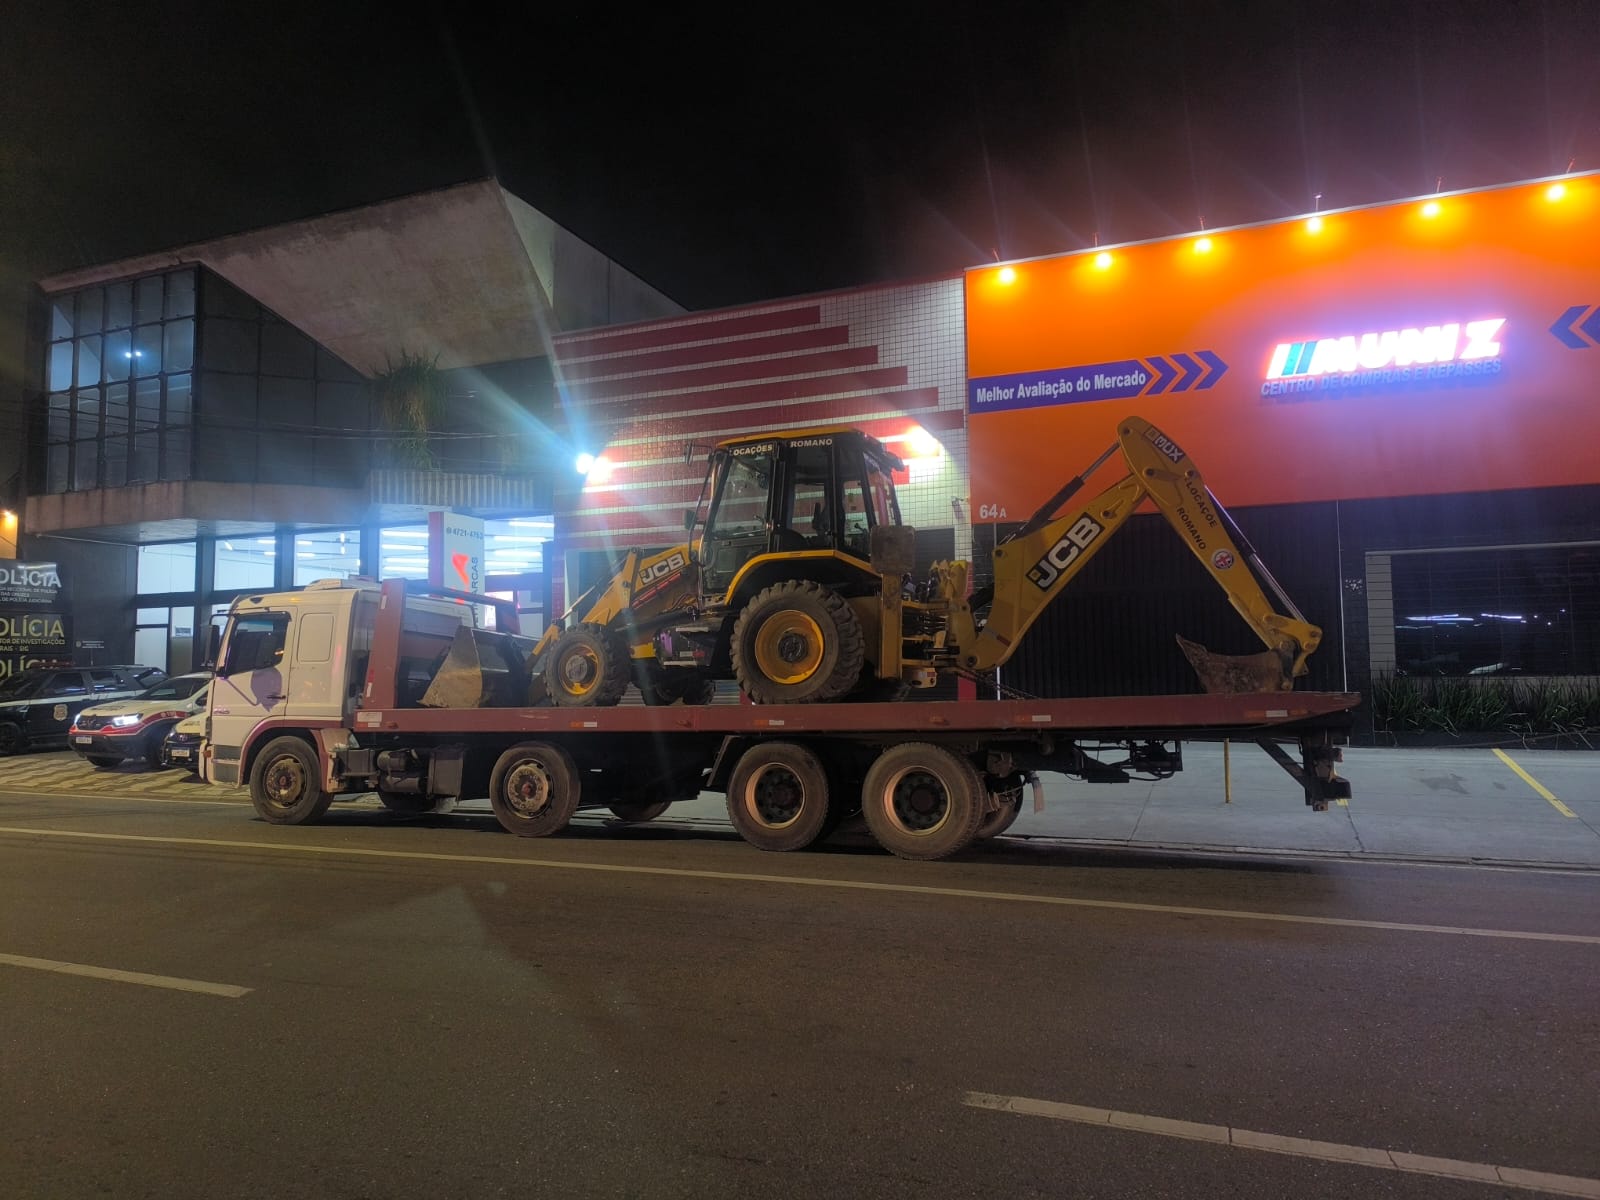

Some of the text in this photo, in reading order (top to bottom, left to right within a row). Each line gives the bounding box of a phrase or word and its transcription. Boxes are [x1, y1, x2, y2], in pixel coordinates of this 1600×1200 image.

[976, 370, 1147, 403] Melhor Avaliação do Mercado
[1260, 359, 1502, 396] CENTRO DE COMPRAS E REPASSES
[730, 443, 773, 456] OCAÇÕES
[790, 438, 833, 449] ROMANO
[1176, 507, 1207, 550] ROMANO
[639, 552, 685, 584] JCB
[1029, 515, 1102, 589] JCB
